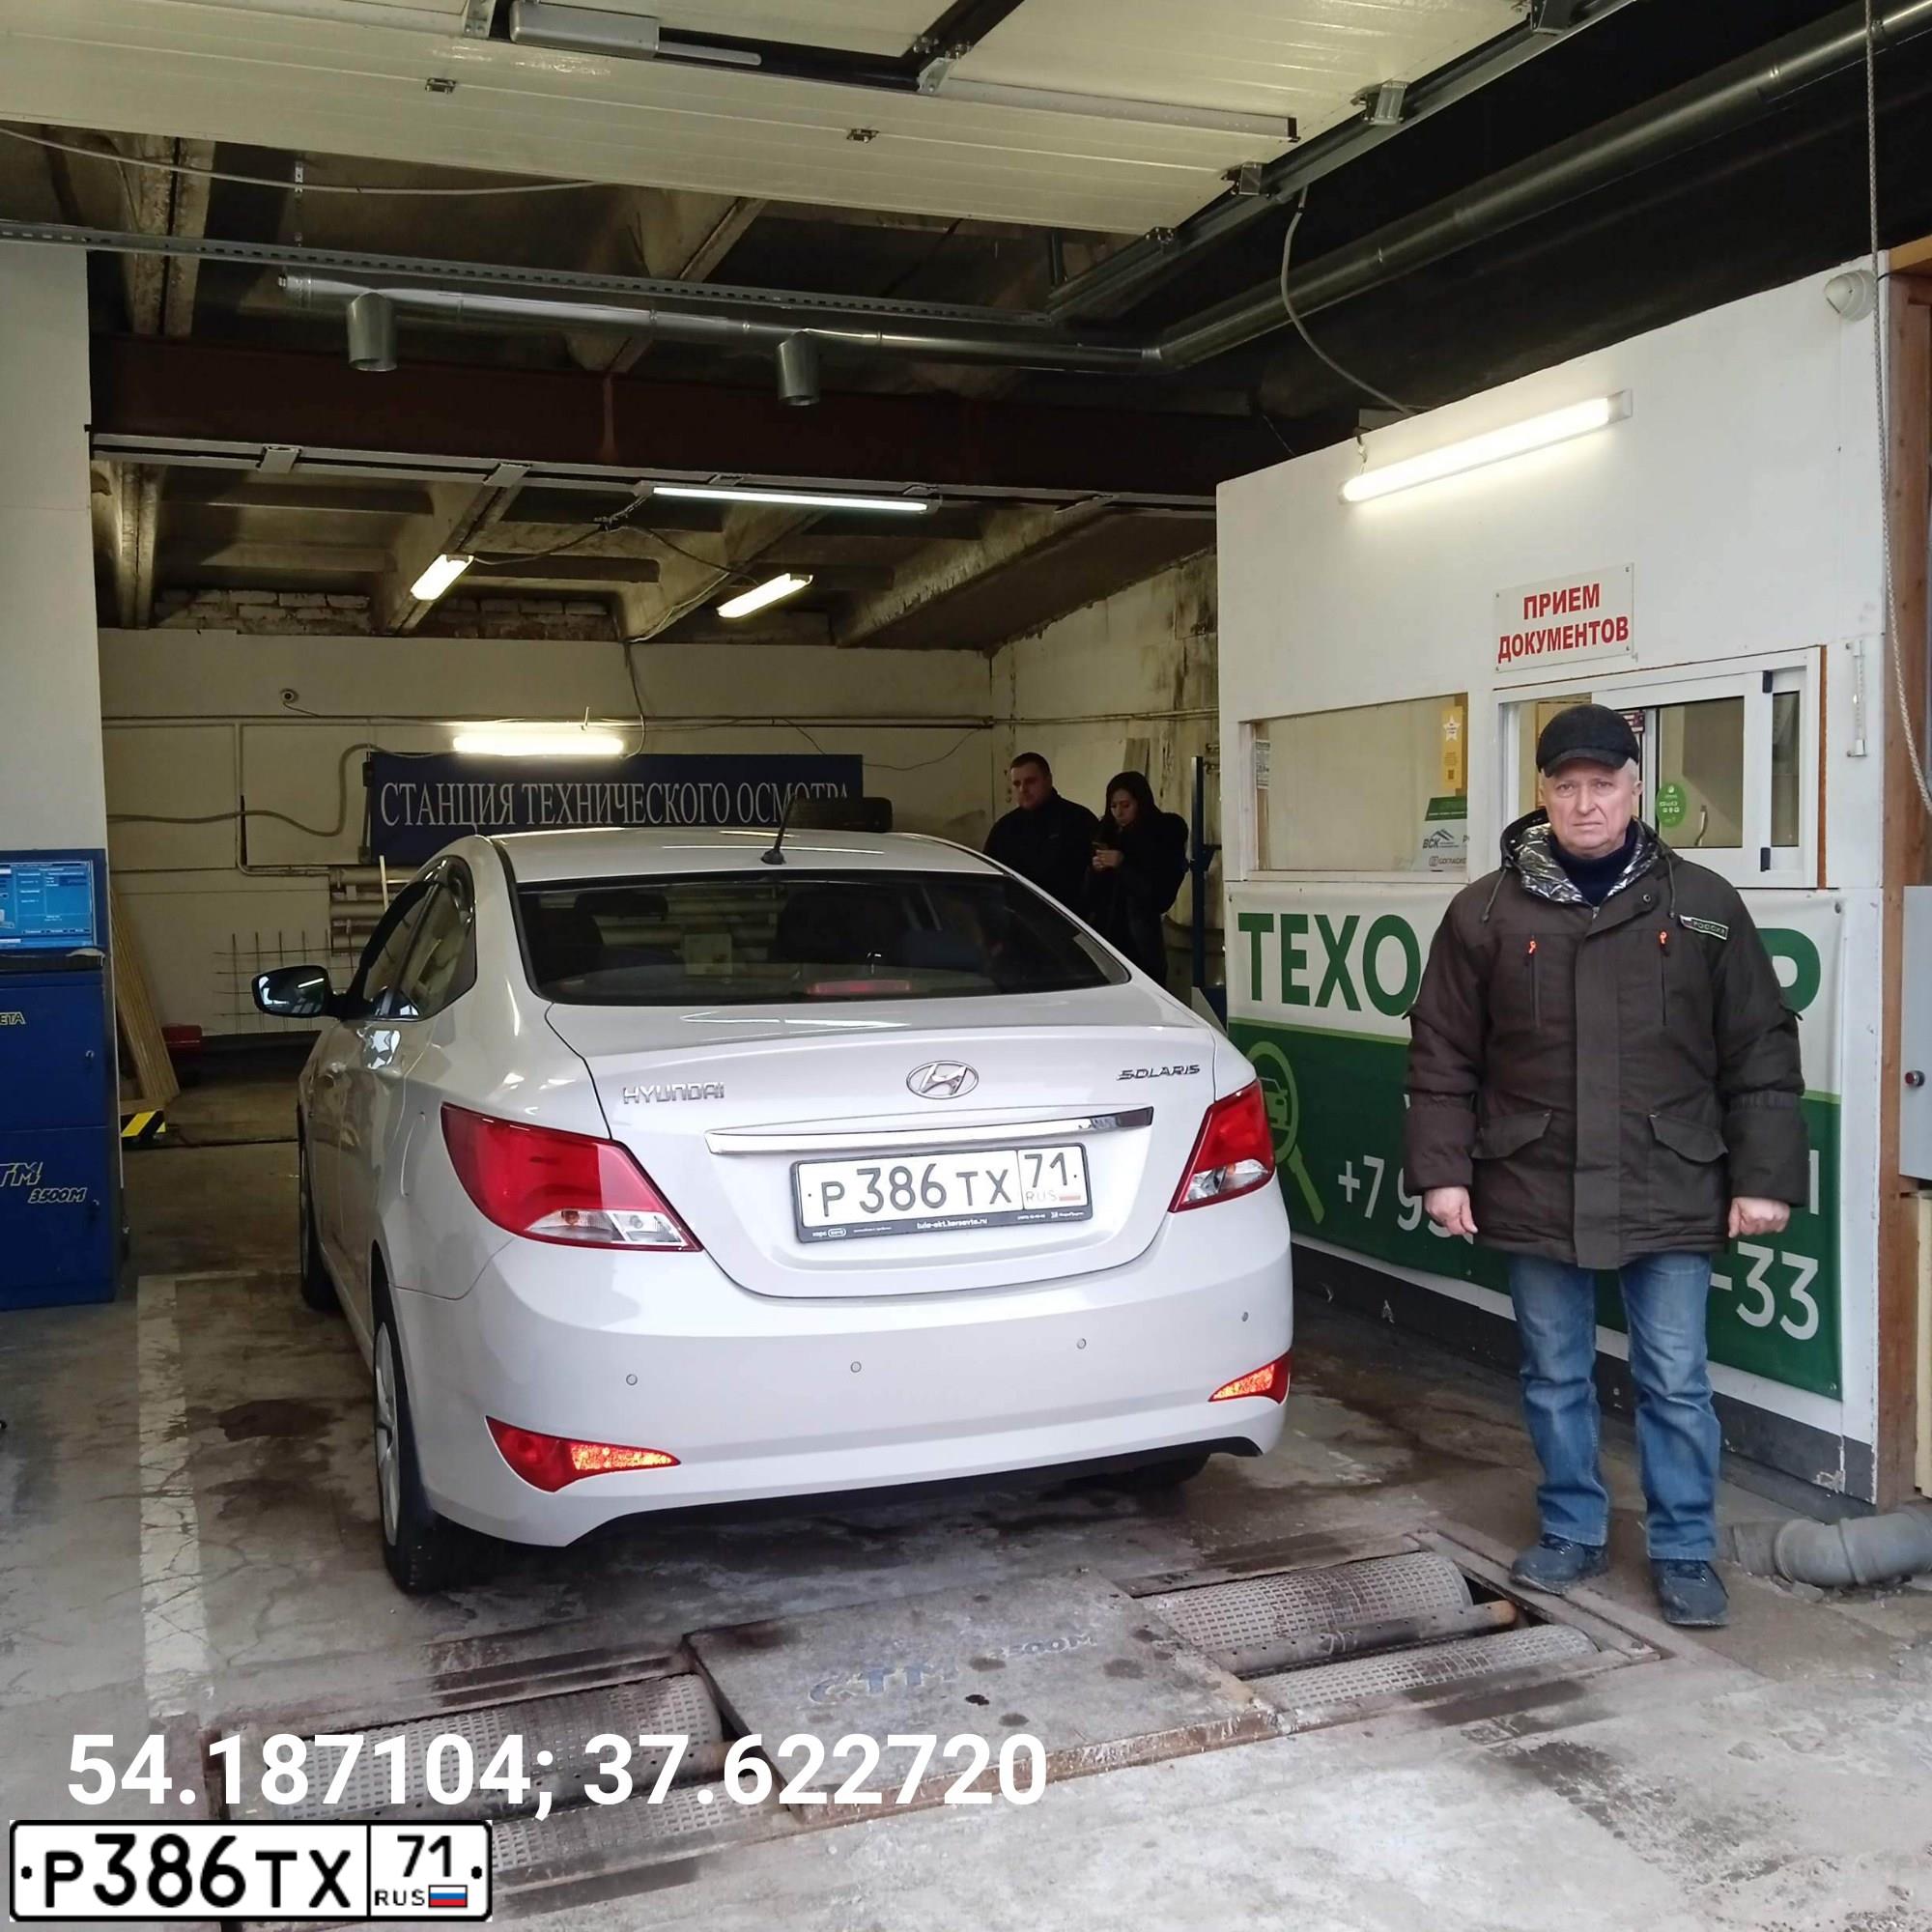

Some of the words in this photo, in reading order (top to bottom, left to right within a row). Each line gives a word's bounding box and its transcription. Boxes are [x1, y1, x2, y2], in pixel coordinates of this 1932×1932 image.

[1523, 583, 1600, 619] ПРИЕМ
[1498, 616, 1629, 664] ДОКУМЕНТОВ
[381, 781, 516, 835] СТАНЦИЯ
[522, 781, 729, 825] ТЕХНИЧЕСКОГО
[1422, 838, 1440, 849] ВСК
[1237, 912, 1821, 1017] ТЕХОР
[0, 1011, 26, 1026] ЕТА
[1118, 1064, 1200, 1081] SOLARIS
[623, 1082, 724, 1104] HYUNDAI
[1024, 1152, 1067, 1188] 71
